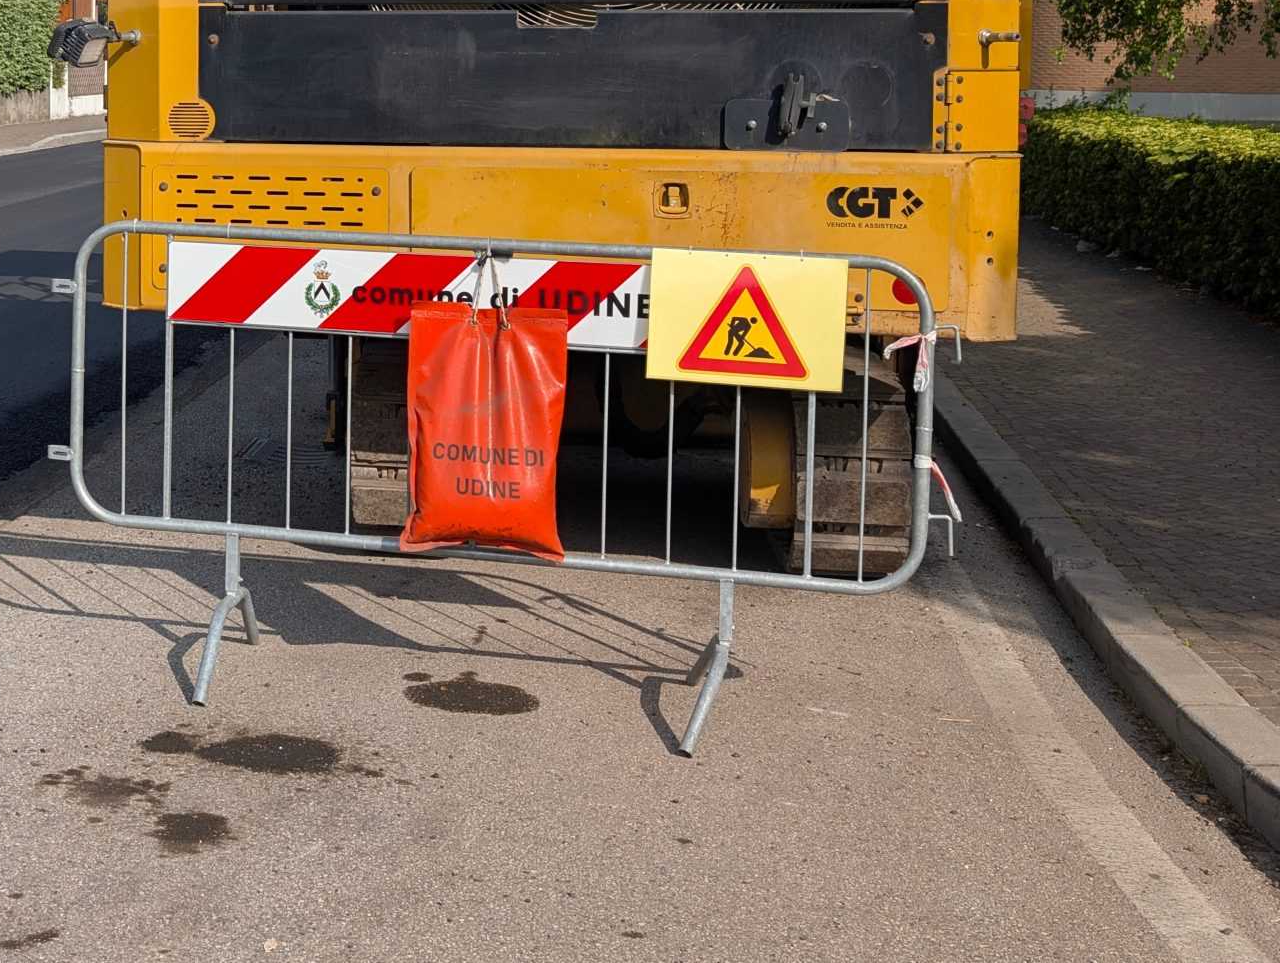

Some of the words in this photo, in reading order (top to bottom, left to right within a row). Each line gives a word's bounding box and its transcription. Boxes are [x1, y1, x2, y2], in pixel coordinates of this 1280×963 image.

[826, 186, 897, 219] CGT
[826, 221, 856, 229] VENDITA
[864, 222, 908, 230] ASSISTENZA
[490, 286, 520, 310] di
[539, 288, 651, 319] UDINE
[432, 442, 520, 466] COMUNE
[524, 448, 545, 467] DI
[456, 476, 521, 499] UDINE
